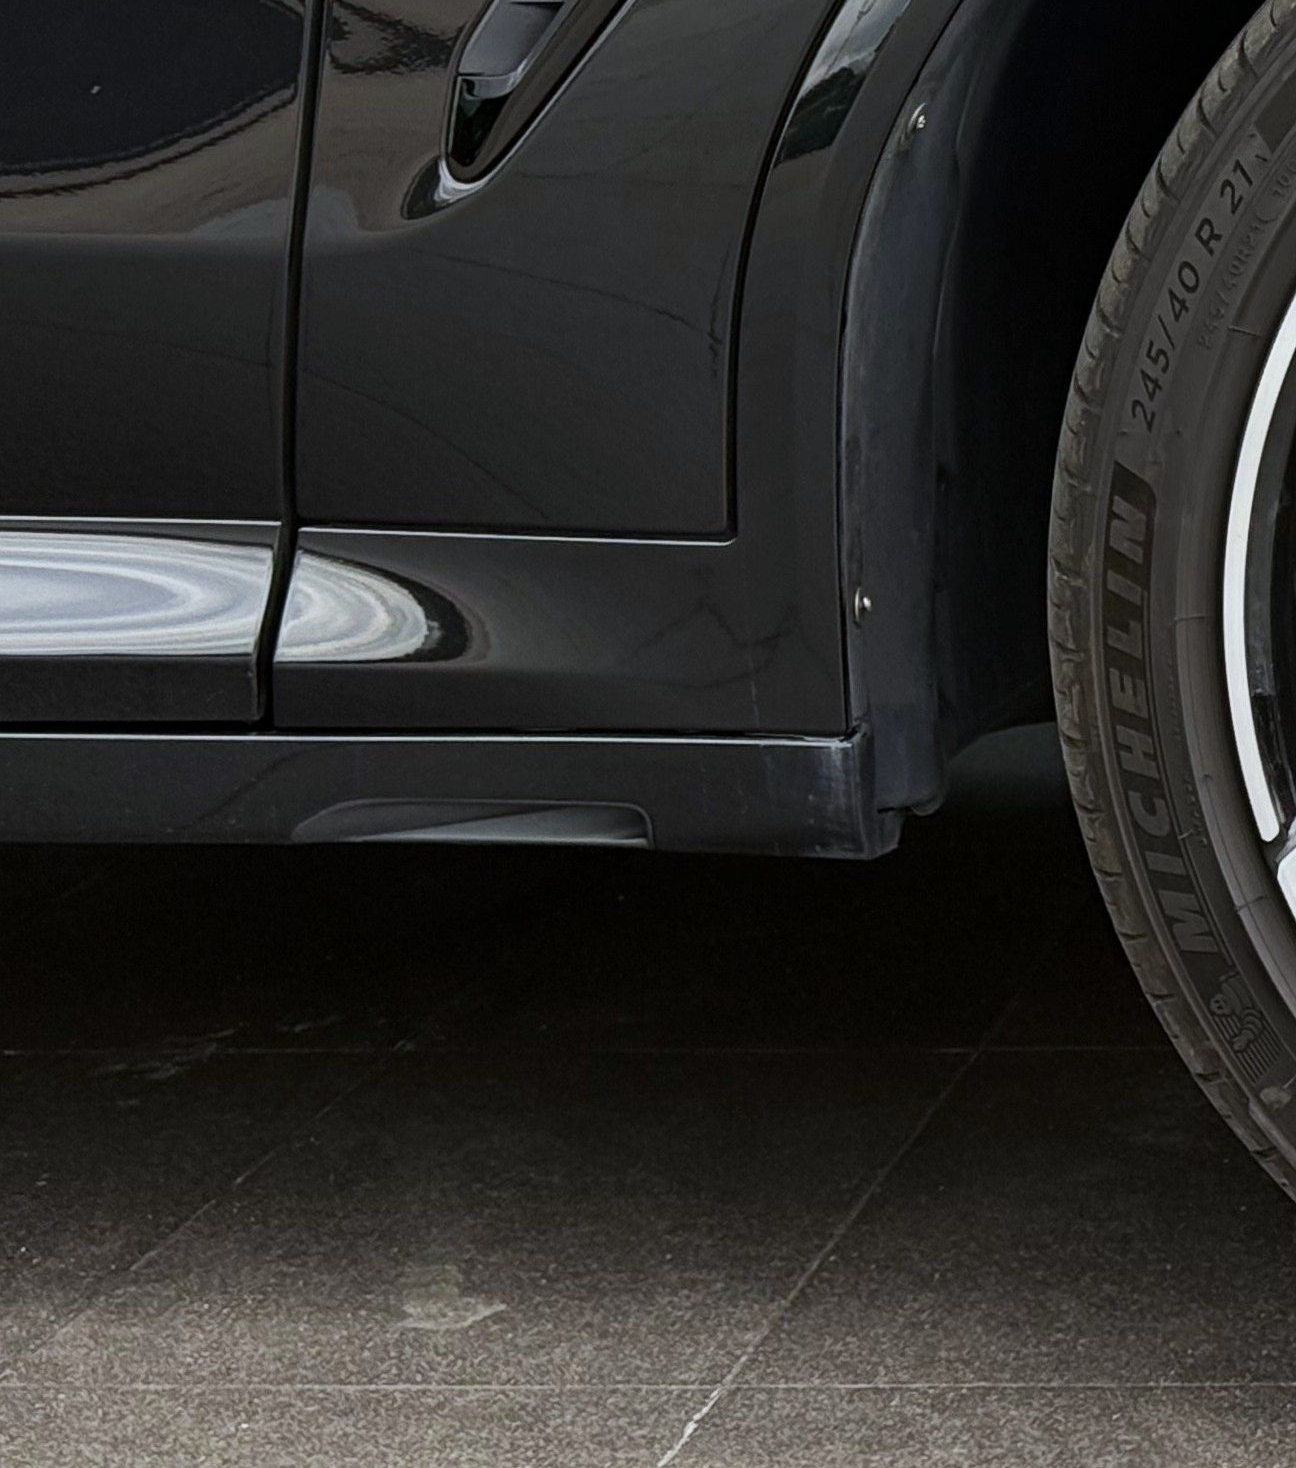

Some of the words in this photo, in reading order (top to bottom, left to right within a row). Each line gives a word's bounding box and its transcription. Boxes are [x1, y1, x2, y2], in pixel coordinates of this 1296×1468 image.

[1130, 260, 1205, 432] 245/40
[1194, 218, 1225, 256] R
[1219, 158, 1256, 217] 21
[1106, 495, 1219, 954] MICHELIN
